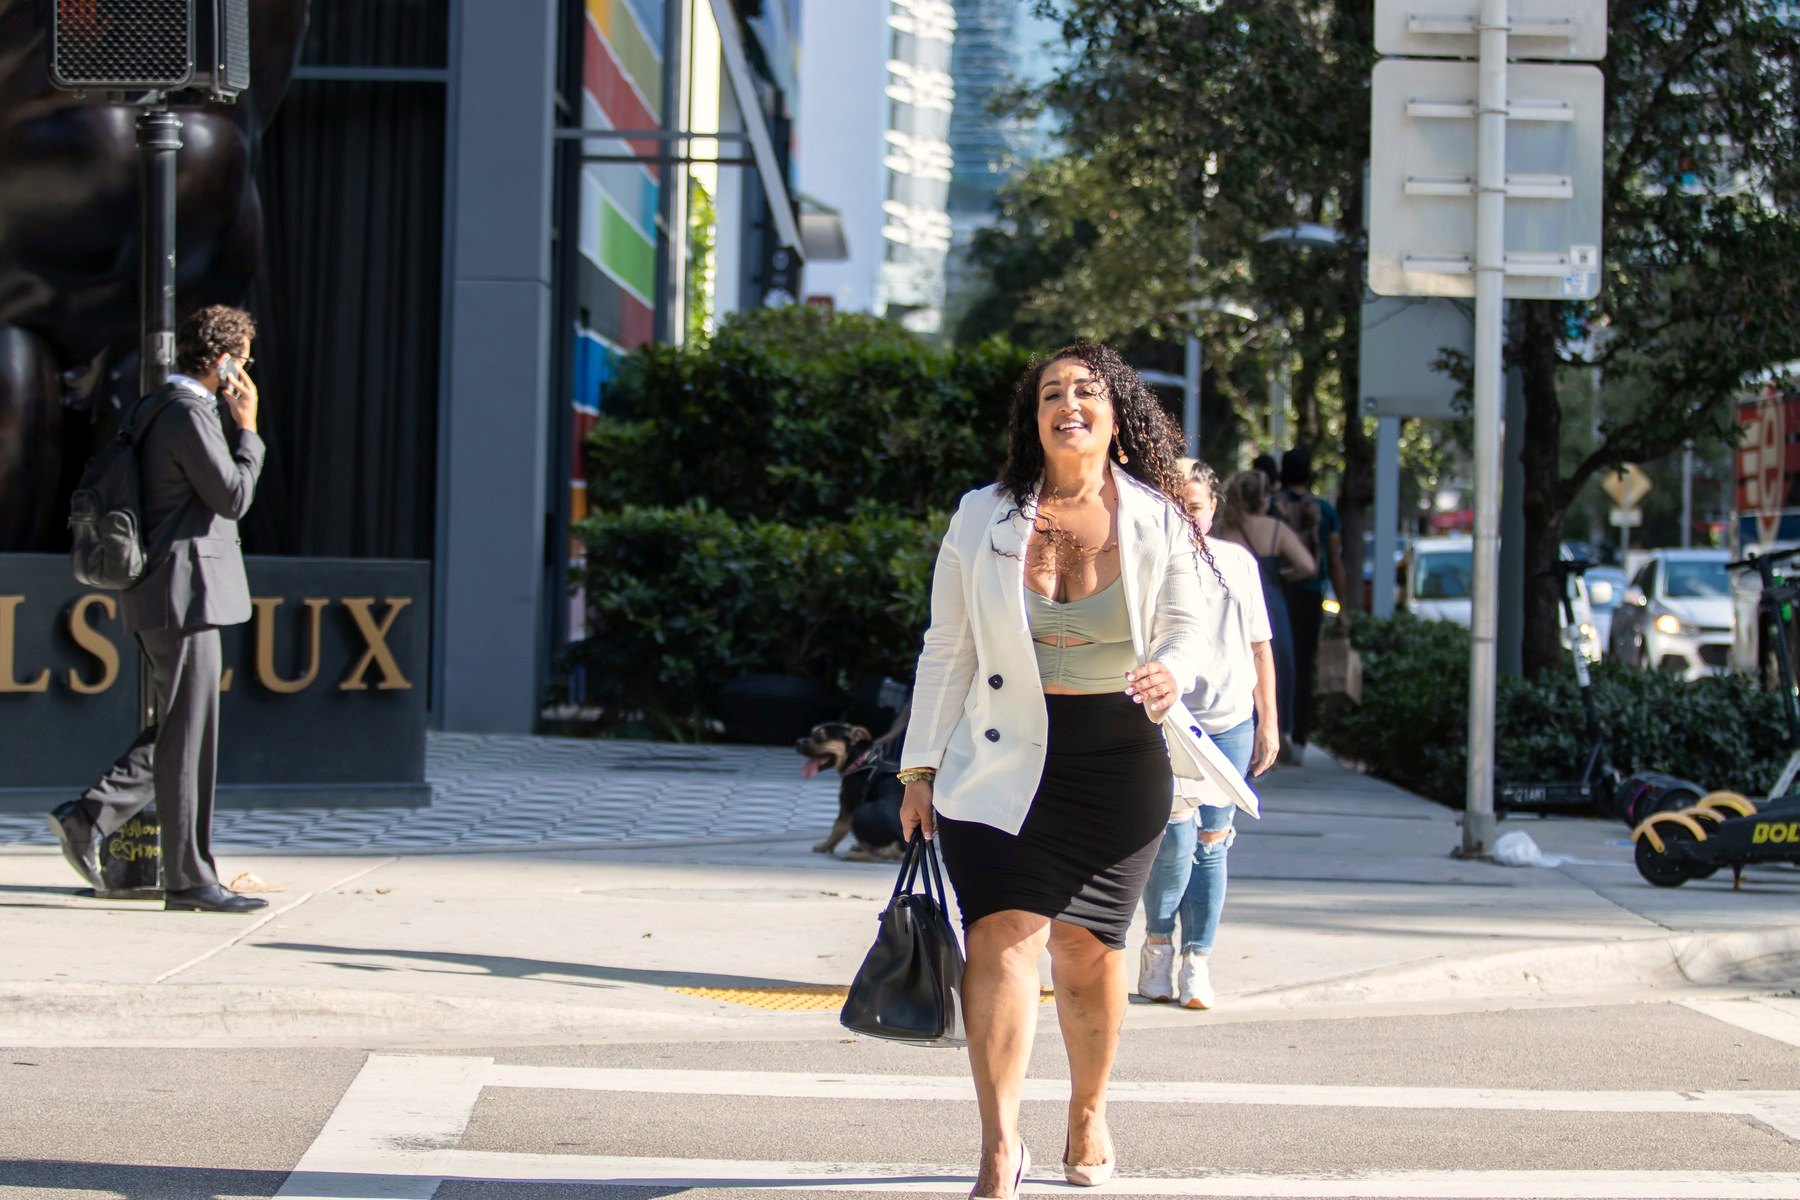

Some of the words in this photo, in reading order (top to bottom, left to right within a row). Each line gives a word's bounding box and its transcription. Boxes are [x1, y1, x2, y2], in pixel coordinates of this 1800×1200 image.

[0, 594, 119, 694] LS
[220, 597, 412, 693] UX
[1752, 822, 1800, 844] BOL
